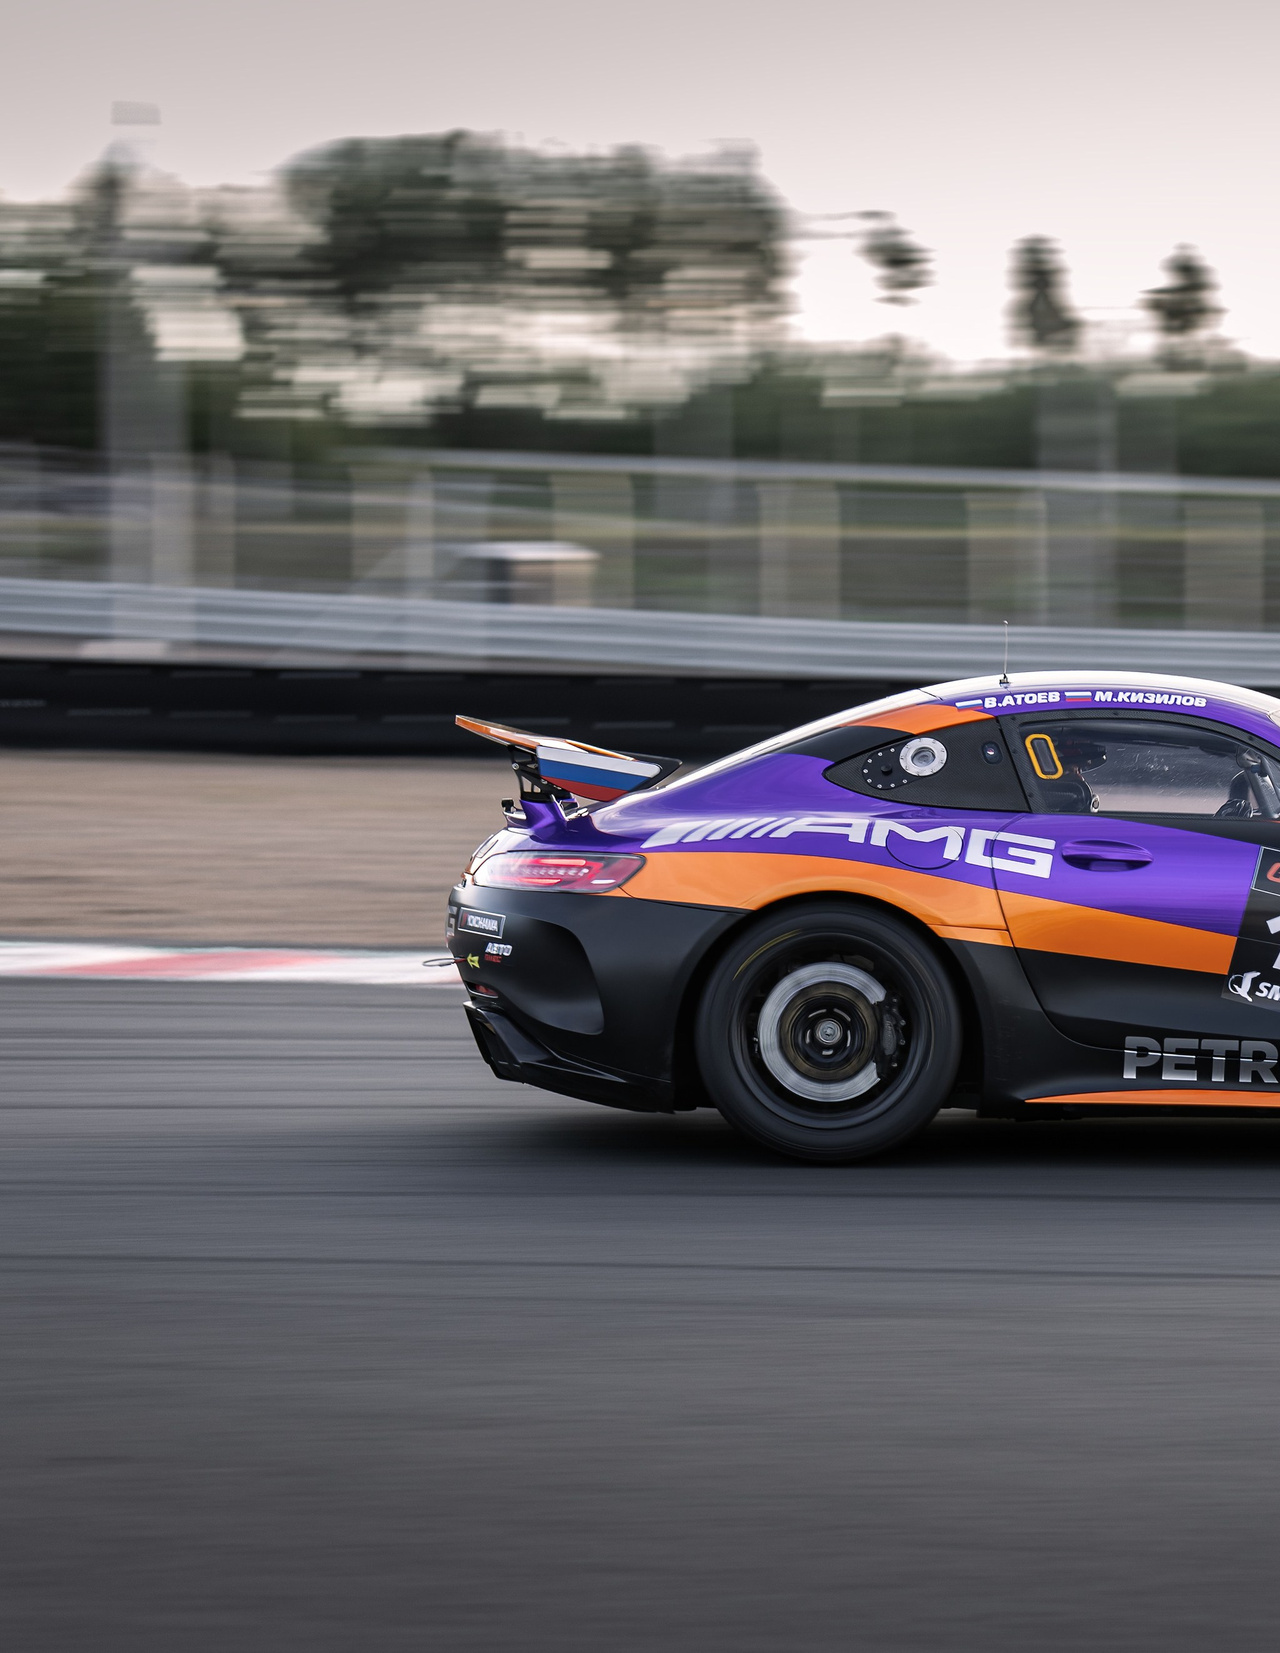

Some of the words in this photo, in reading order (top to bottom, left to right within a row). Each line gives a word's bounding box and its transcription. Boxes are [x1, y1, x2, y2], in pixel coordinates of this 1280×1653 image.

[984, 691, 1061, 708] В.АТОЕВ
[1094, 691, 1207, 708] М.КИЗИЛОВ
[769, 817, 1056, 879] AMG
